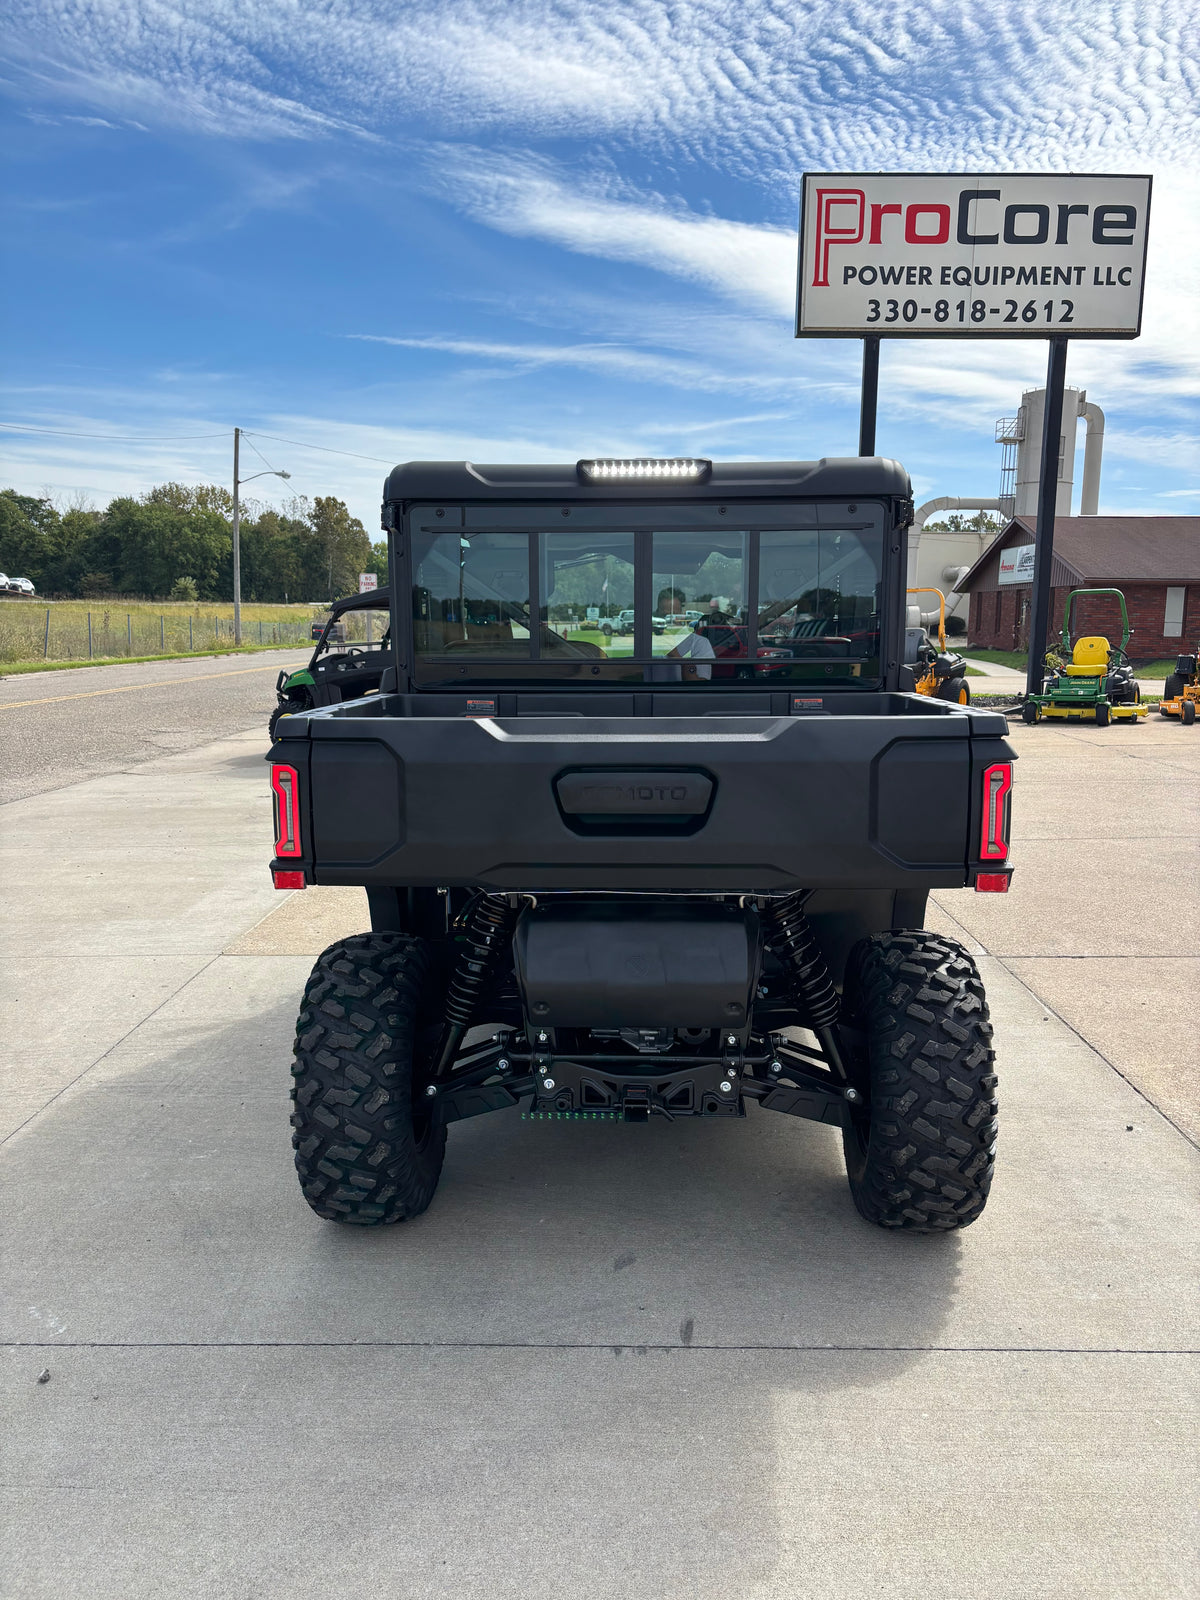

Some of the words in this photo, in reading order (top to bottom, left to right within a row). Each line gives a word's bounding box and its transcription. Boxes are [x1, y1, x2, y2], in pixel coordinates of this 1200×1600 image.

[812, 188, 1136, 286] ProCore
[842, 266, 932, 285] POWER
[940, 266, 1085, 287] EQUIPMENT
[1093, 267, 1132, 286] LLC
[866, 299, 1074, 322] 330-818-2612
